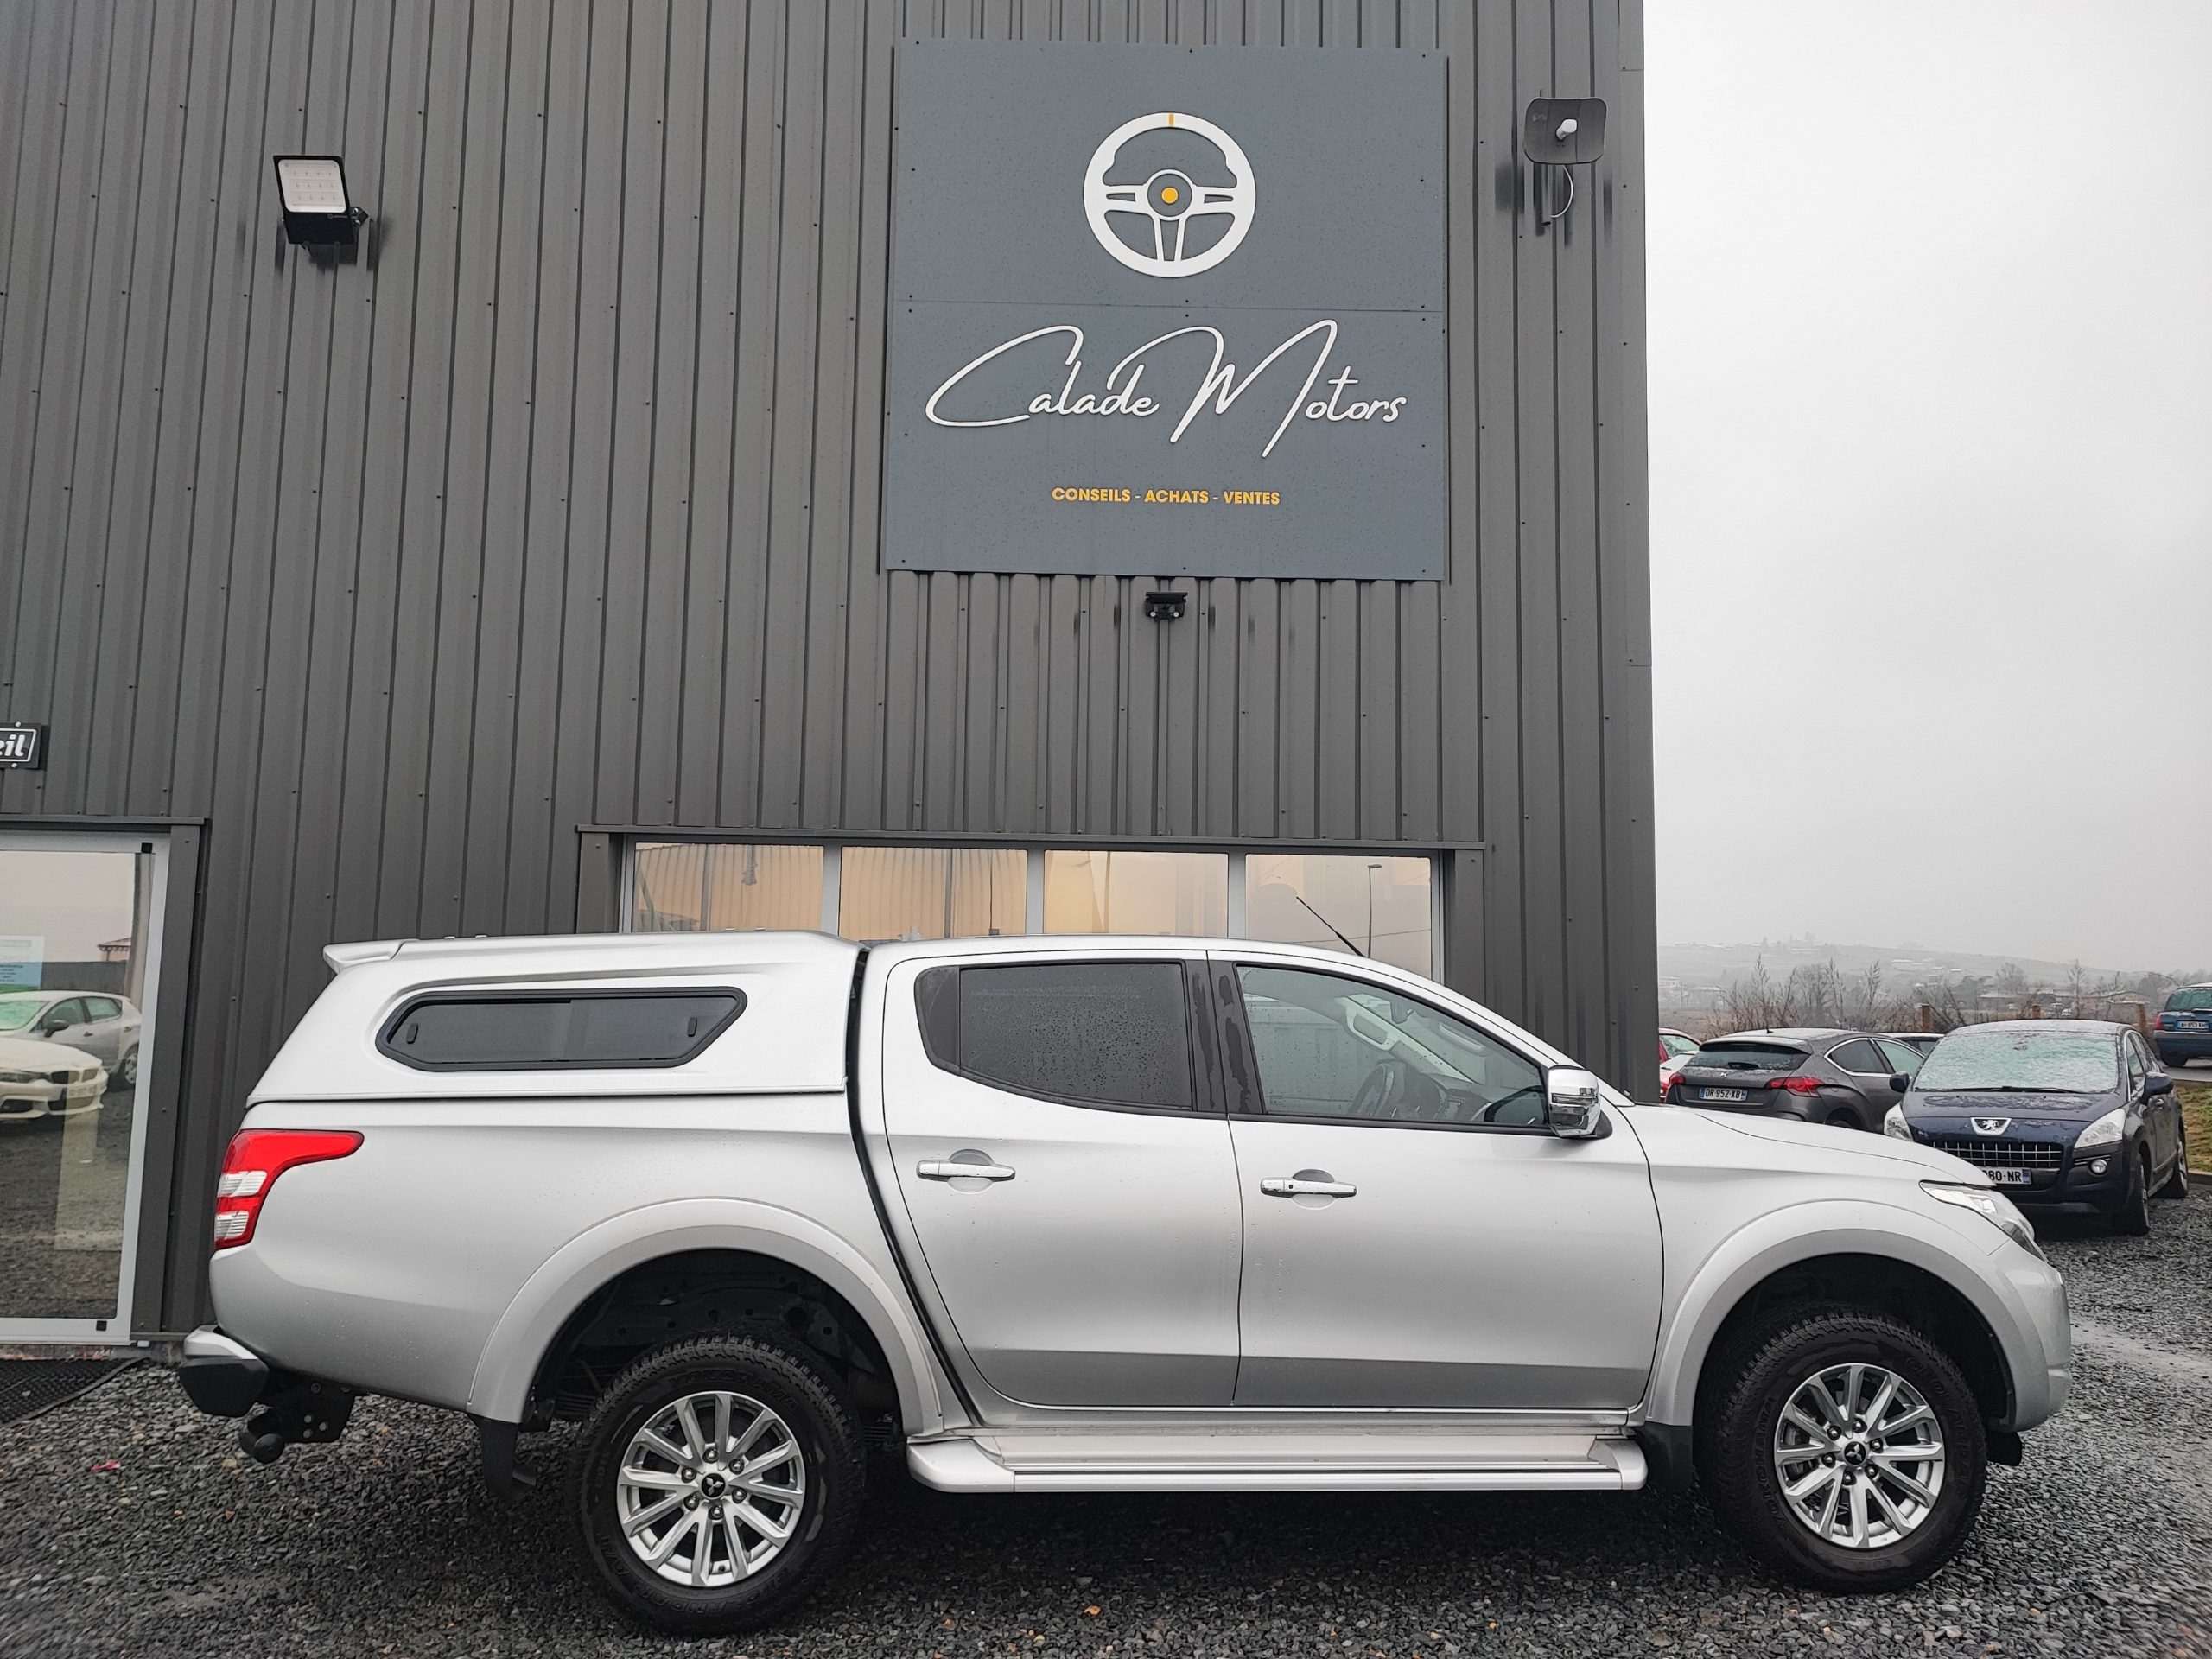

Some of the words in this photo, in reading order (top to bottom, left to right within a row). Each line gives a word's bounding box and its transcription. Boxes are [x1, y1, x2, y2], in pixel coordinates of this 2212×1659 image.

[925, 325, 1160, 427] Calade
[1106, 318, 1408, 458] Motors
[1051, 486, 1131, 503] CONSEILS
[1144, 488, 1210, 504] ACHATS
[1223, 490, 1281, 505] VENTES
[1982, 1169, 2022, 1183] 80-NR
